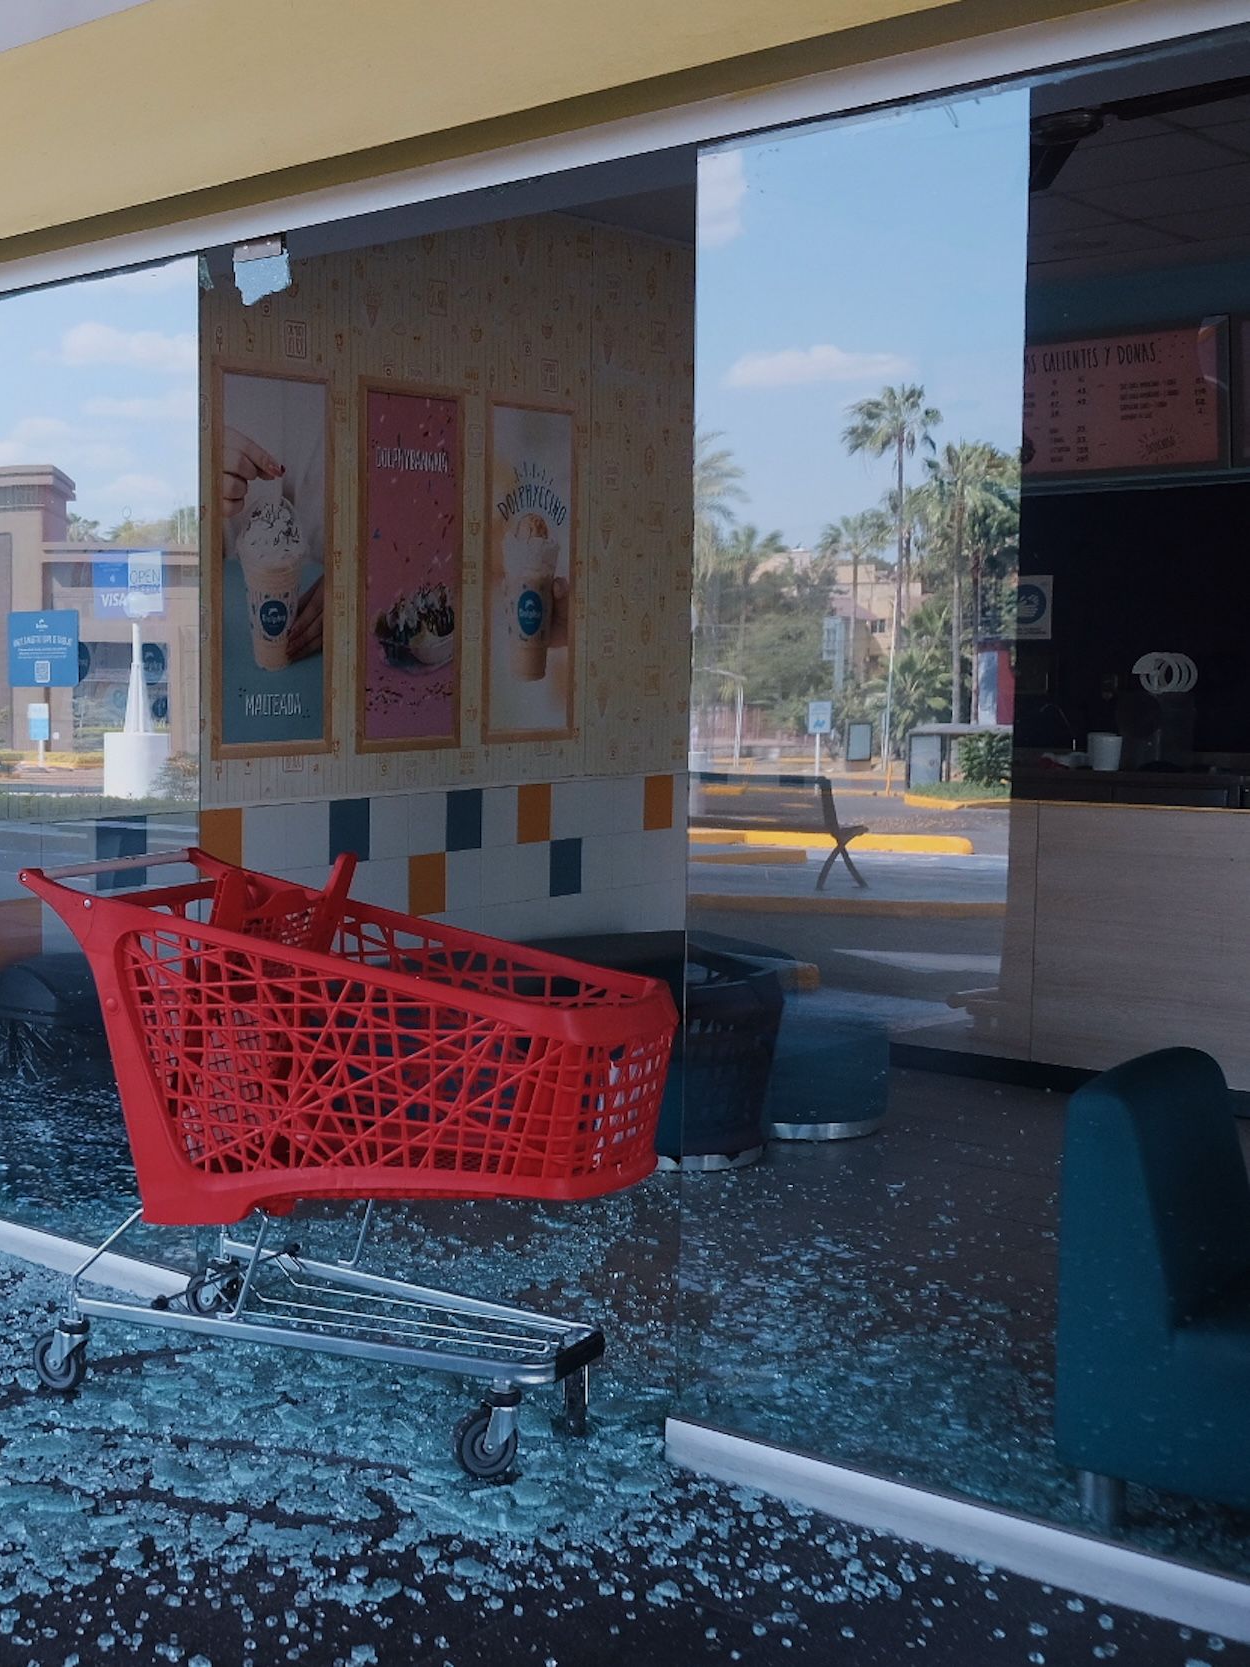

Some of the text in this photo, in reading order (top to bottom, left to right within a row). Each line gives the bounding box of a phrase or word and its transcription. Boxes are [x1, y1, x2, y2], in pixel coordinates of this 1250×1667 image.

[1043, 347, 1099, 373] CALIENTES
[1104, 345, 1111, 367] Y
[1117, 342, 1156, 365] DONAS
[130, 569, 160, 585] OPEN
[101, 592, 127, 607] VISA
[245, 693, 302, 717] MALTEADA
